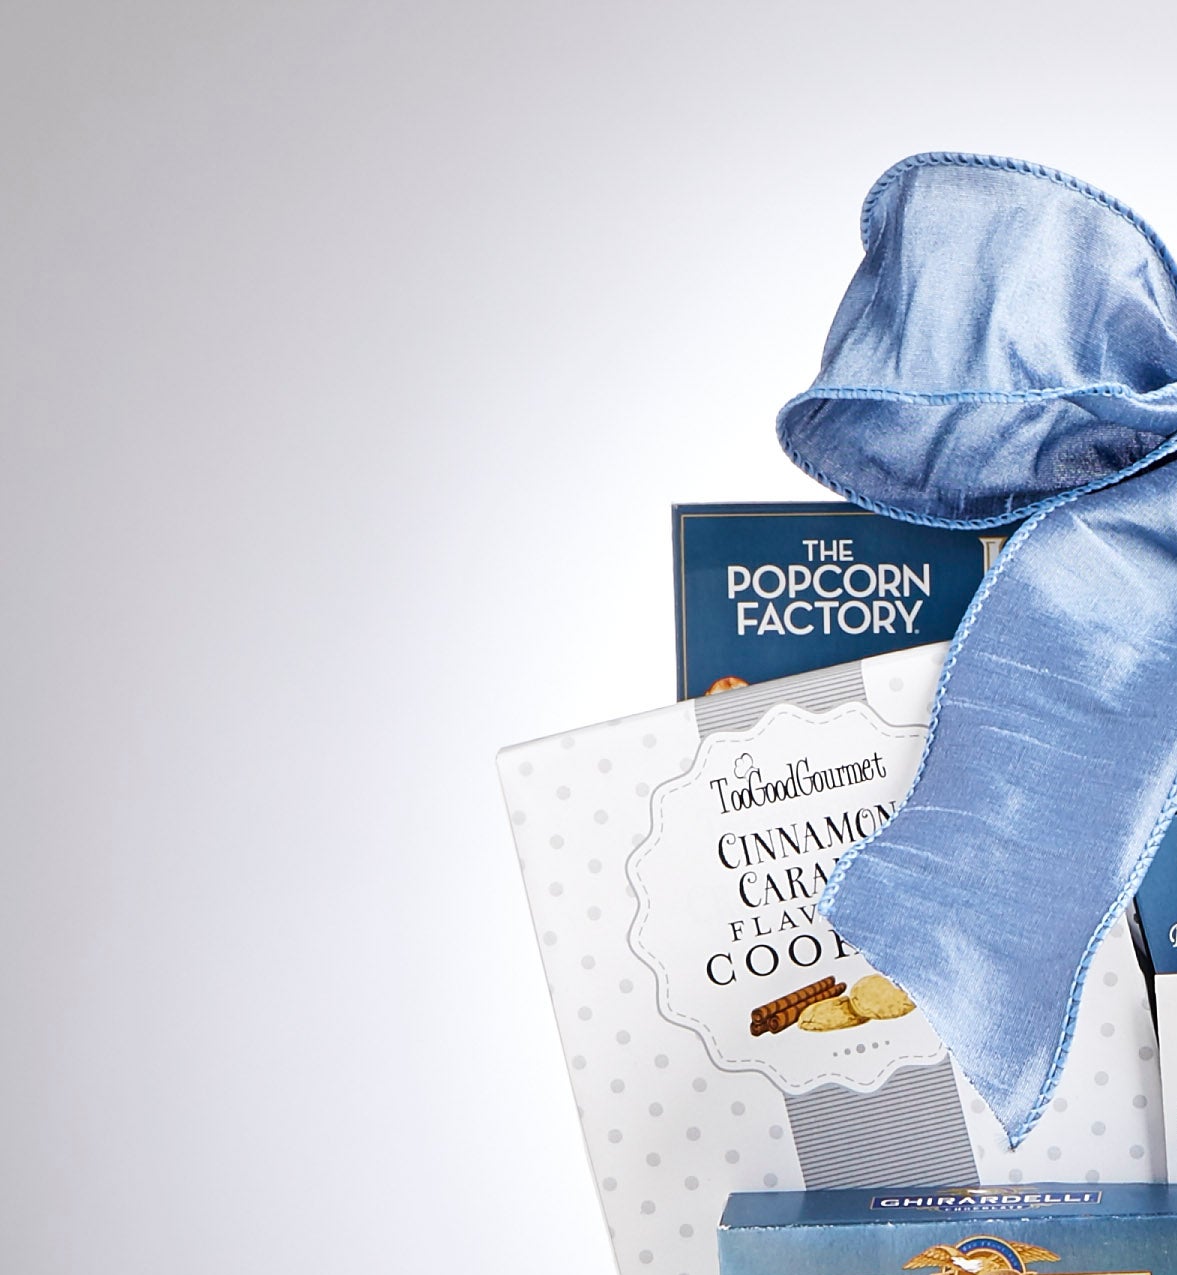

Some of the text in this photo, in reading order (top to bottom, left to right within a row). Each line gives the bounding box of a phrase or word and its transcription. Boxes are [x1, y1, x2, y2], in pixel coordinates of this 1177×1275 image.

[802, 539, 854, 562] THE
[727, 563, 931, 599] POPCORN
[738, 857, 840, 908] CARA
[880, 1193, 1092, 1207] GHIRARDELLI
